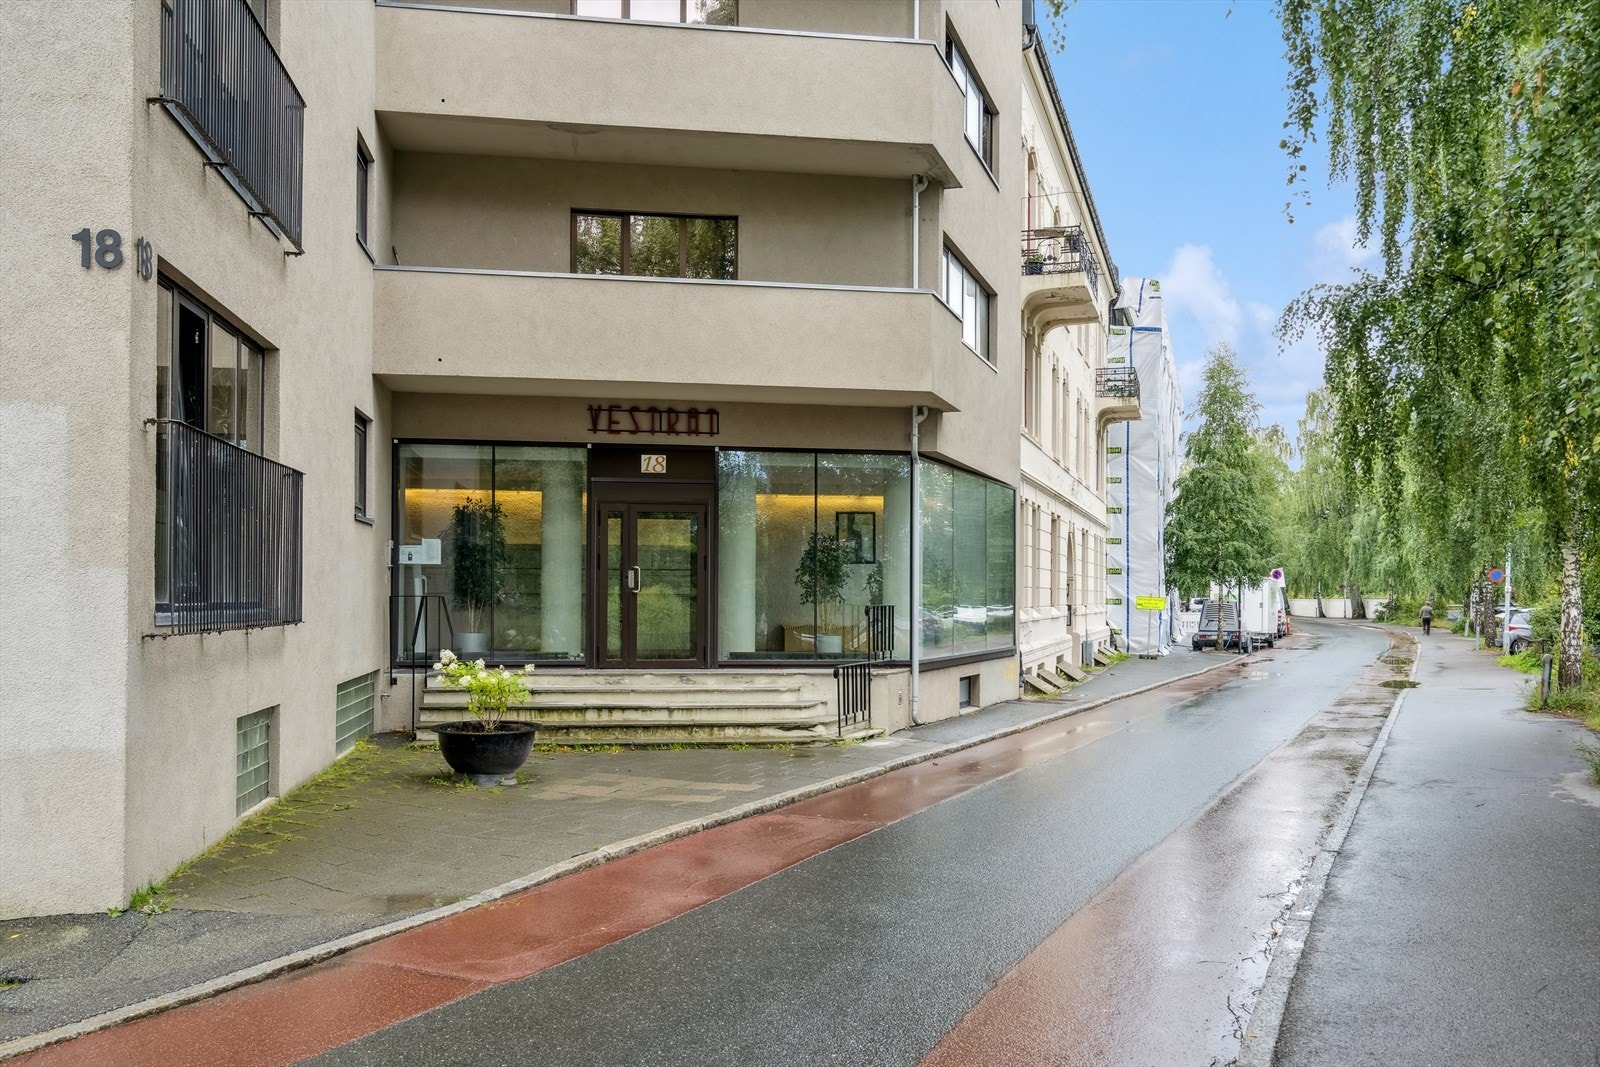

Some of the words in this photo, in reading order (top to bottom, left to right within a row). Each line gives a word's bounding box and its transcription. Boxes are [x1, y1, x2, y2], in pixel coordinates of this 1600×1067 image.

[72, 228, 123, 269] 18
[137, 236, 153, 280] 18
[642, 455, 666, 473] 18
